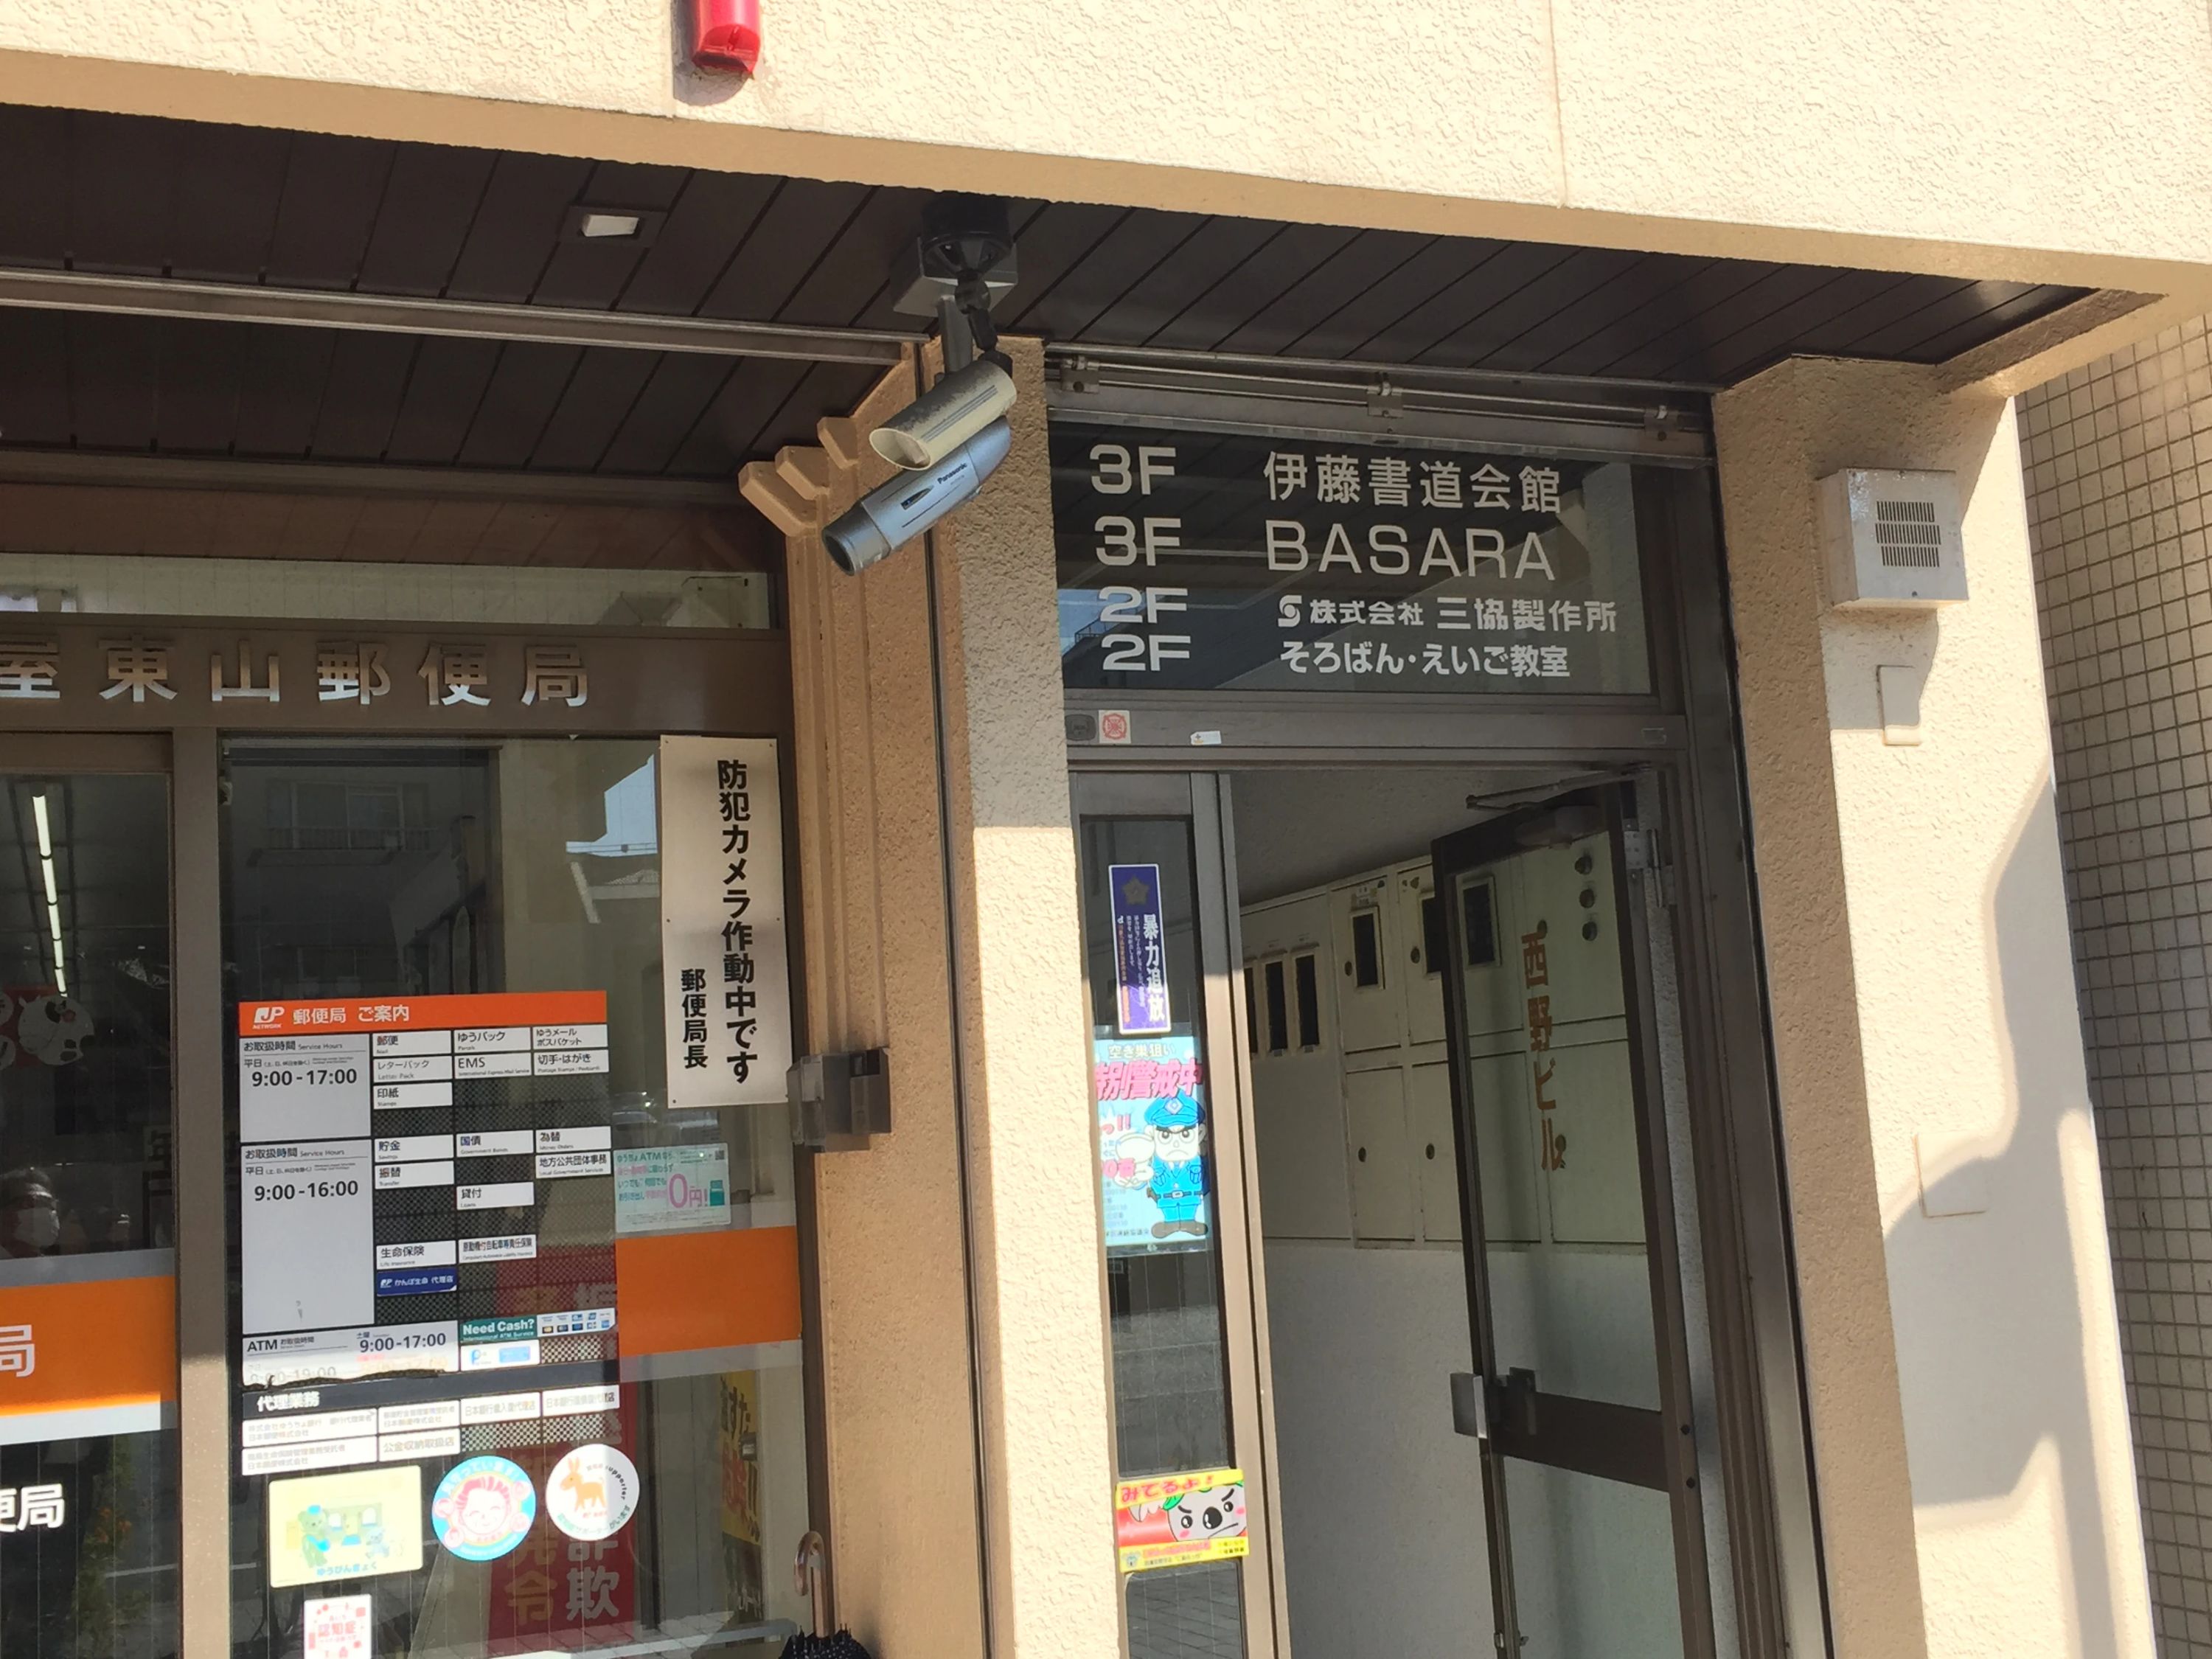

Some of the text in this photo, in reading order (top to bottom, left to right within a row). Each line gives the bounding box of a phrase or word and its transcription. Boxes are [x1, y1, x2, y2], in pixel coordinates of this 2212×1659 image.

[937, 462, 967, 484] Panasonic
[1089, 445, 1176, 495] 3F
[1264, 450, 1561, 514] 伊藤書道会館
[1094, 515, 1181, 566] 3F
[1265, 519, 1556, 581] BASARA
[1098, 586, 1188, 624] 2F
[1310, 597, 1424, 626] 株式会社
[1436, 597, 1617, 633] 三協製作所
[1101, 635, 1191, 672] 2F
[1279, 641, 1571, 678] そろばん・えいご教室
[717, 759, 758, 1084] 防犯カメラ作動中です
[1143, 914, 1165, 1022] 暴力追放
[293, 1004, 410, 1025] 郵便局 ご案内
[681, 968, 709, 1069] 郵便局長
[458, 1032, 505, 1043] ゆうパック
[536, 1029, 577, 1037] ゆうメール
[244, 1040, 296, 1051] お取扱時間
[377, 1035, 399, 1046] 郵便
[1109, 1043, 1175, 1059] 空き巣狙い
[244, 1059, 262, 1068] 平日
[378, 1060, 429, 1070] レターパック
[458, 1057, 485, 1068] EMS
[377, 1088, 399, 1098] 印紙
[460, 1135, 481, 1146] 国債
[540, 1132, 560, 1142] 為替
[379, 1141, 400, 1151] 貯金
[245, 1147, 297, 1159] お取扱時間
[539, 1154, 607, 1167] 地方公共団体事務
[246, 1166, 263, 1175] 平日
[380, 1167, 400, 1178] 振替
[461, 1189, 481, 1199] 貸付
[380, 1245, 425, 1258] 生命保険
[463, 1323, 495, 1335] Need
[497, 1318, 535, 1332] Cash?
[247, 1339, 277, 1352] ATM
[257, 1391, 320, 1412] 代理業務
